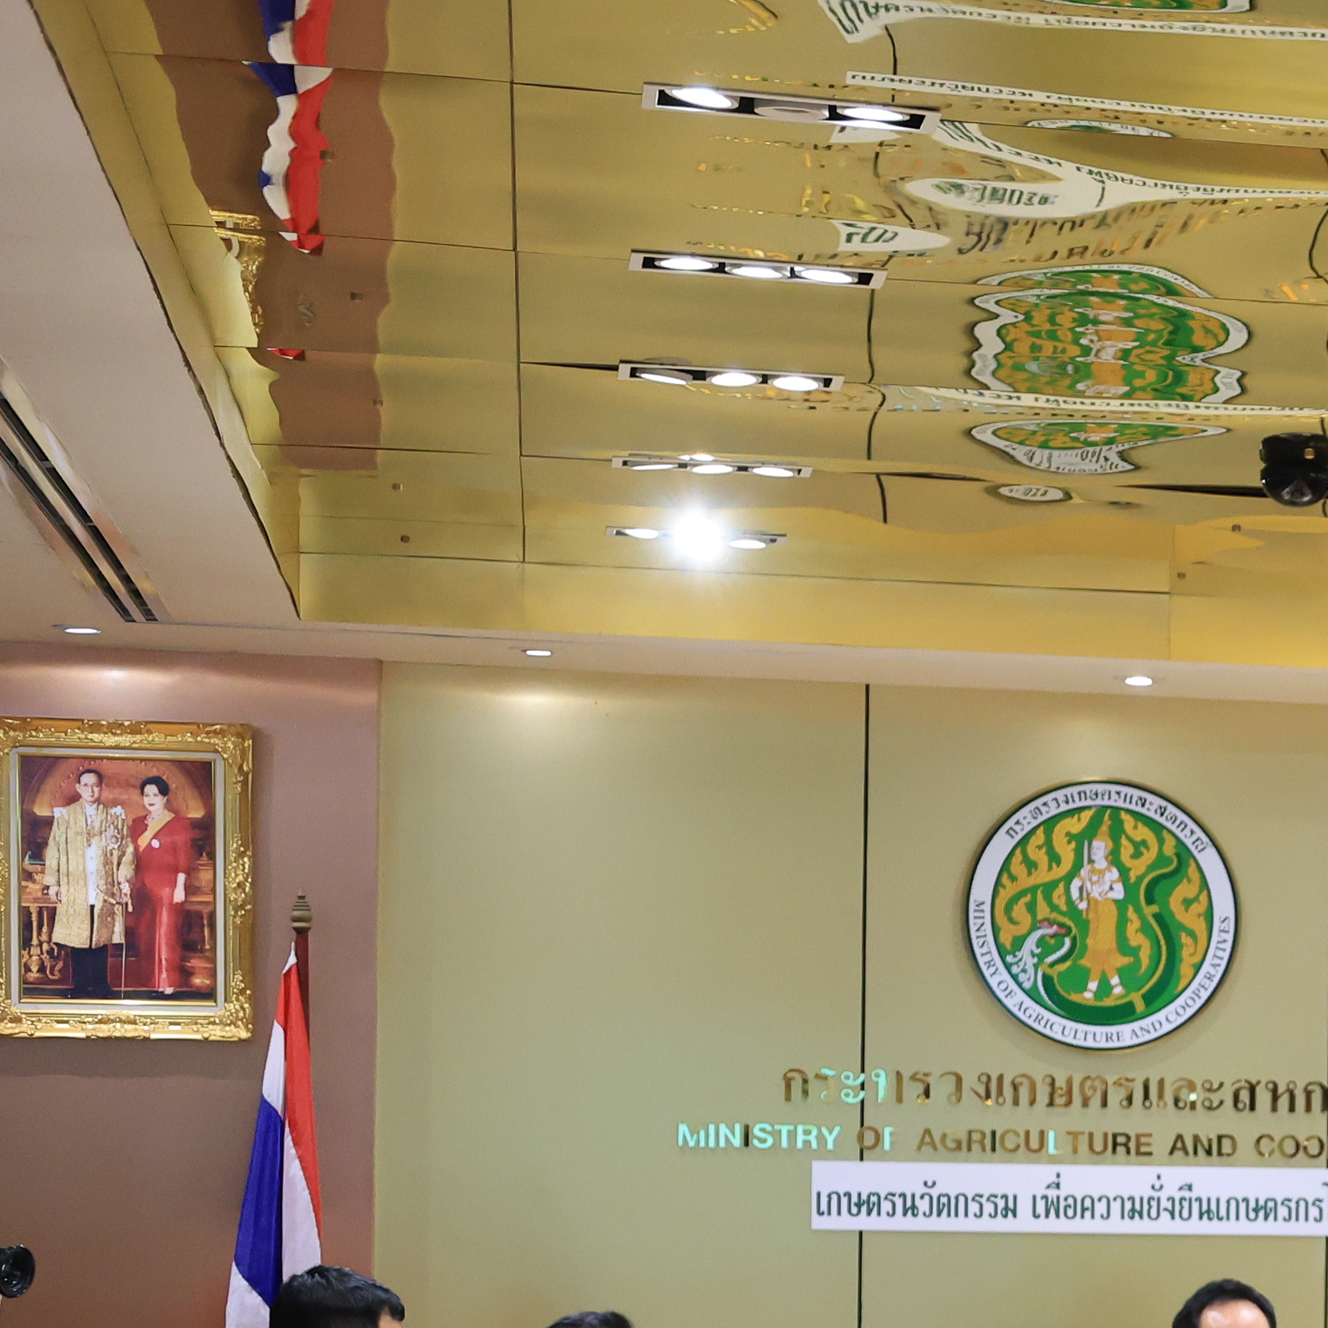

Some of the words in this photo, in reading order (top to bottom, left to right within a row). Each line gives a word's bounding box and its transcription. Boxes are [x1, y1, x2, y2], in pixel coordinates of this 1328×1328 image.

[972, 899, 1002, 977] MINISTRY
[997, 978, 1016, 1001] OF
[1014, 1000, 1126, 1043] AGRICULTURE
[1130, 1019, 1163, 1041] AND
[1164, 915, 1231, 1024] COOPERATIVES
[676, 1122, 842, 1151] MINISTRY
[856, 1125, 899, 1152] OF
[916, 1127, 1154, 1157] AGRICULTURE
[1168, 1133, 1238, 1158] AND
[815, 1180, 1018, 1219] เกษตรนวัตกรรม
